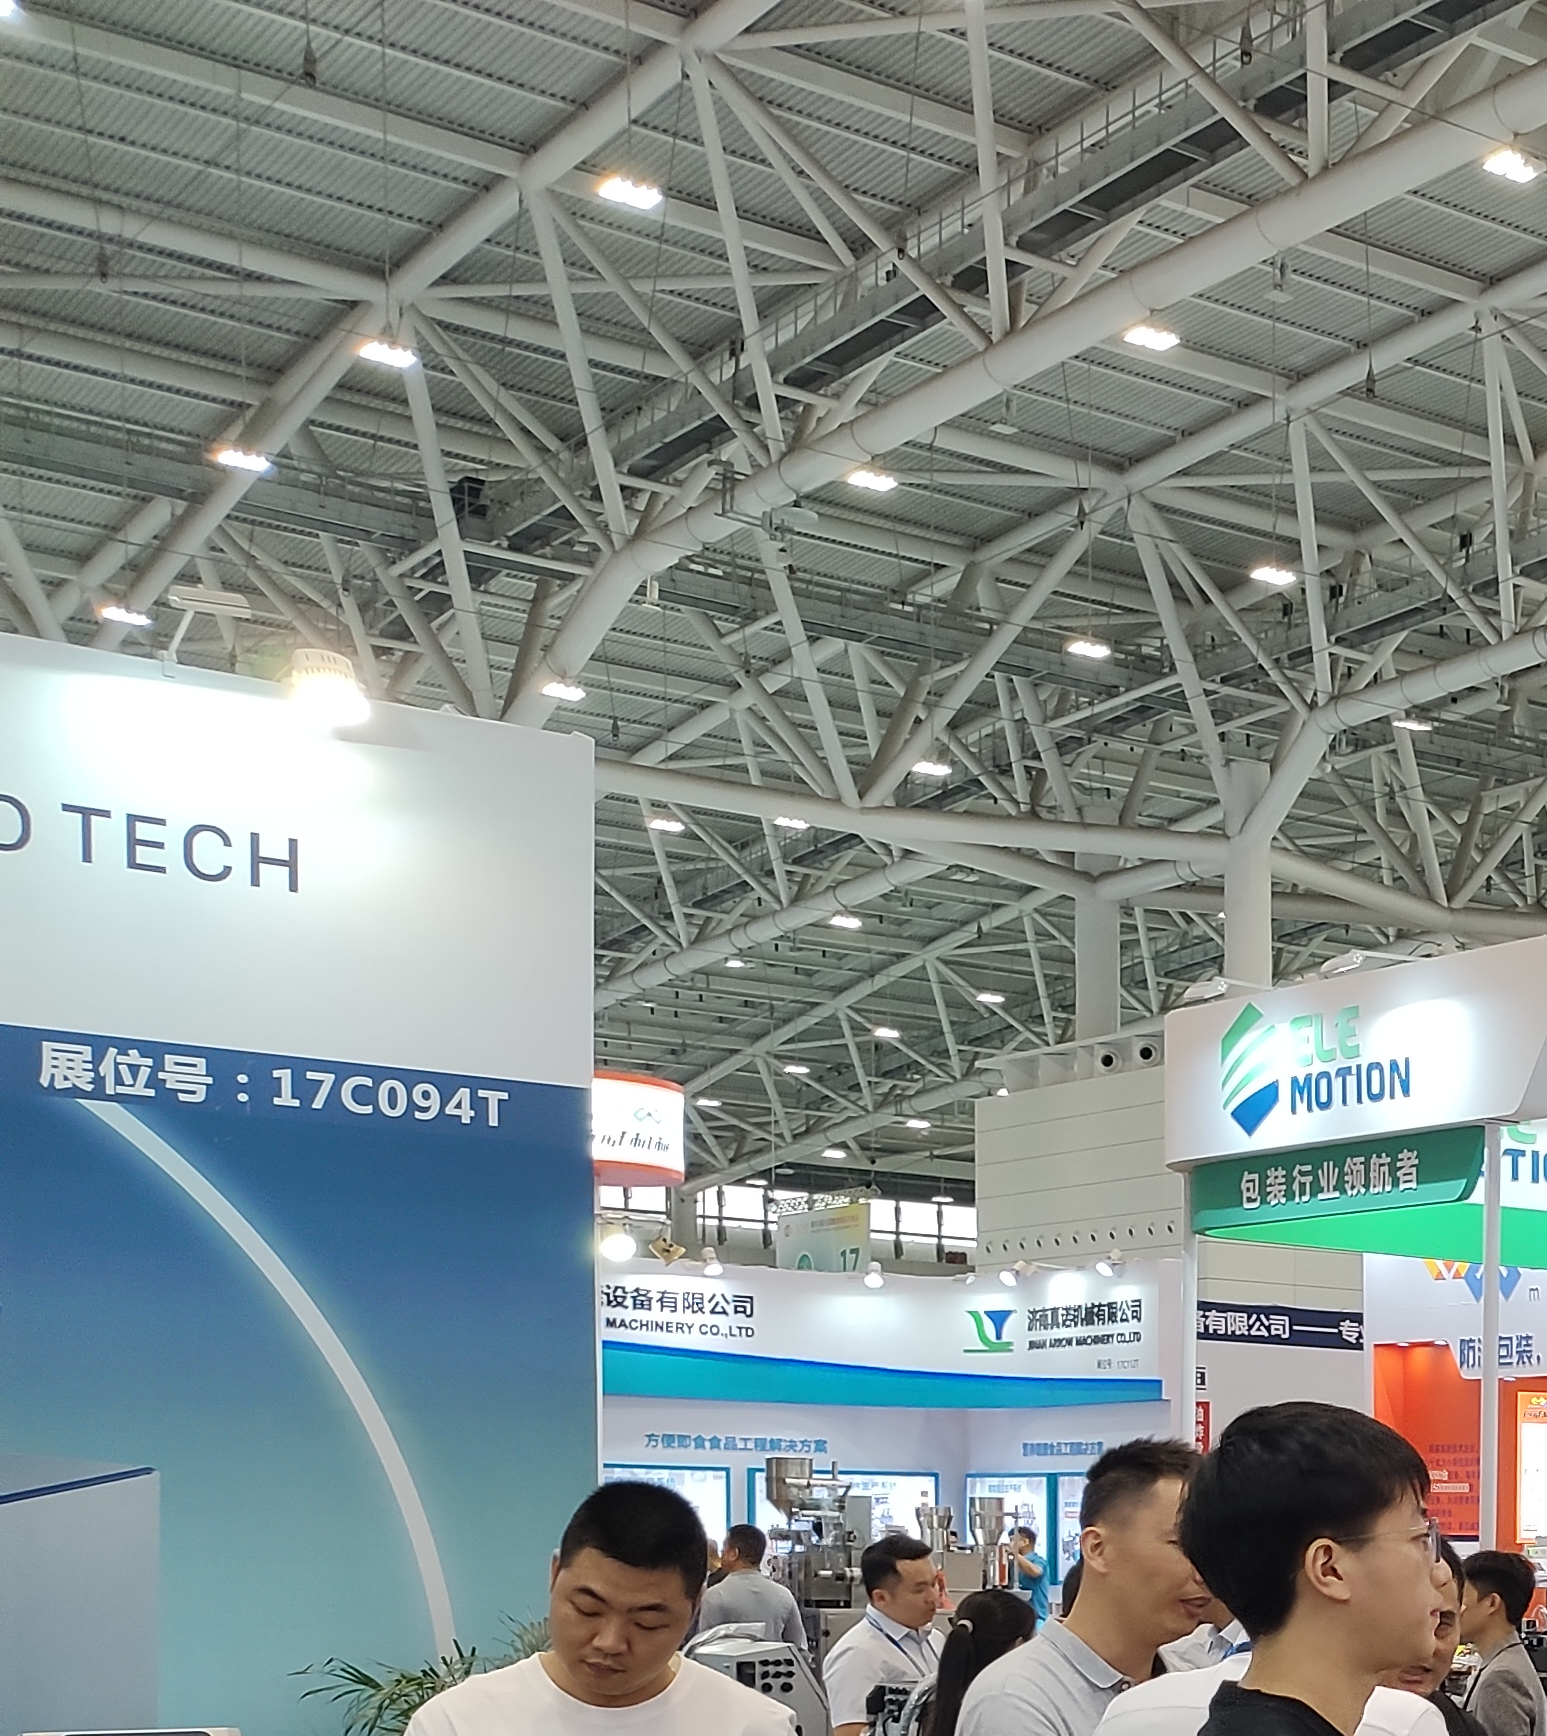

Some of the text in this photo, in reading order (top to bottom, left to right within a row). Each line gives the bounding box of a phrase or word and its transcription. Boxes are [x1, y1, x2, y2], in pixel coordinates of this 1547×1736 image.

[61, 802, 301, 894] TECH
[1290, 1056, 1411, 1115] MOTION
[1240, 1148, 1420, 1210] 包装行业领航者
[600, 1284, 755, 1320] 设备有限公司
[606, 1316, 755, 1340] MACHINERY CO.,LTD
[645, 1432, 828, 1454] 方便即食食品工程解决方案
